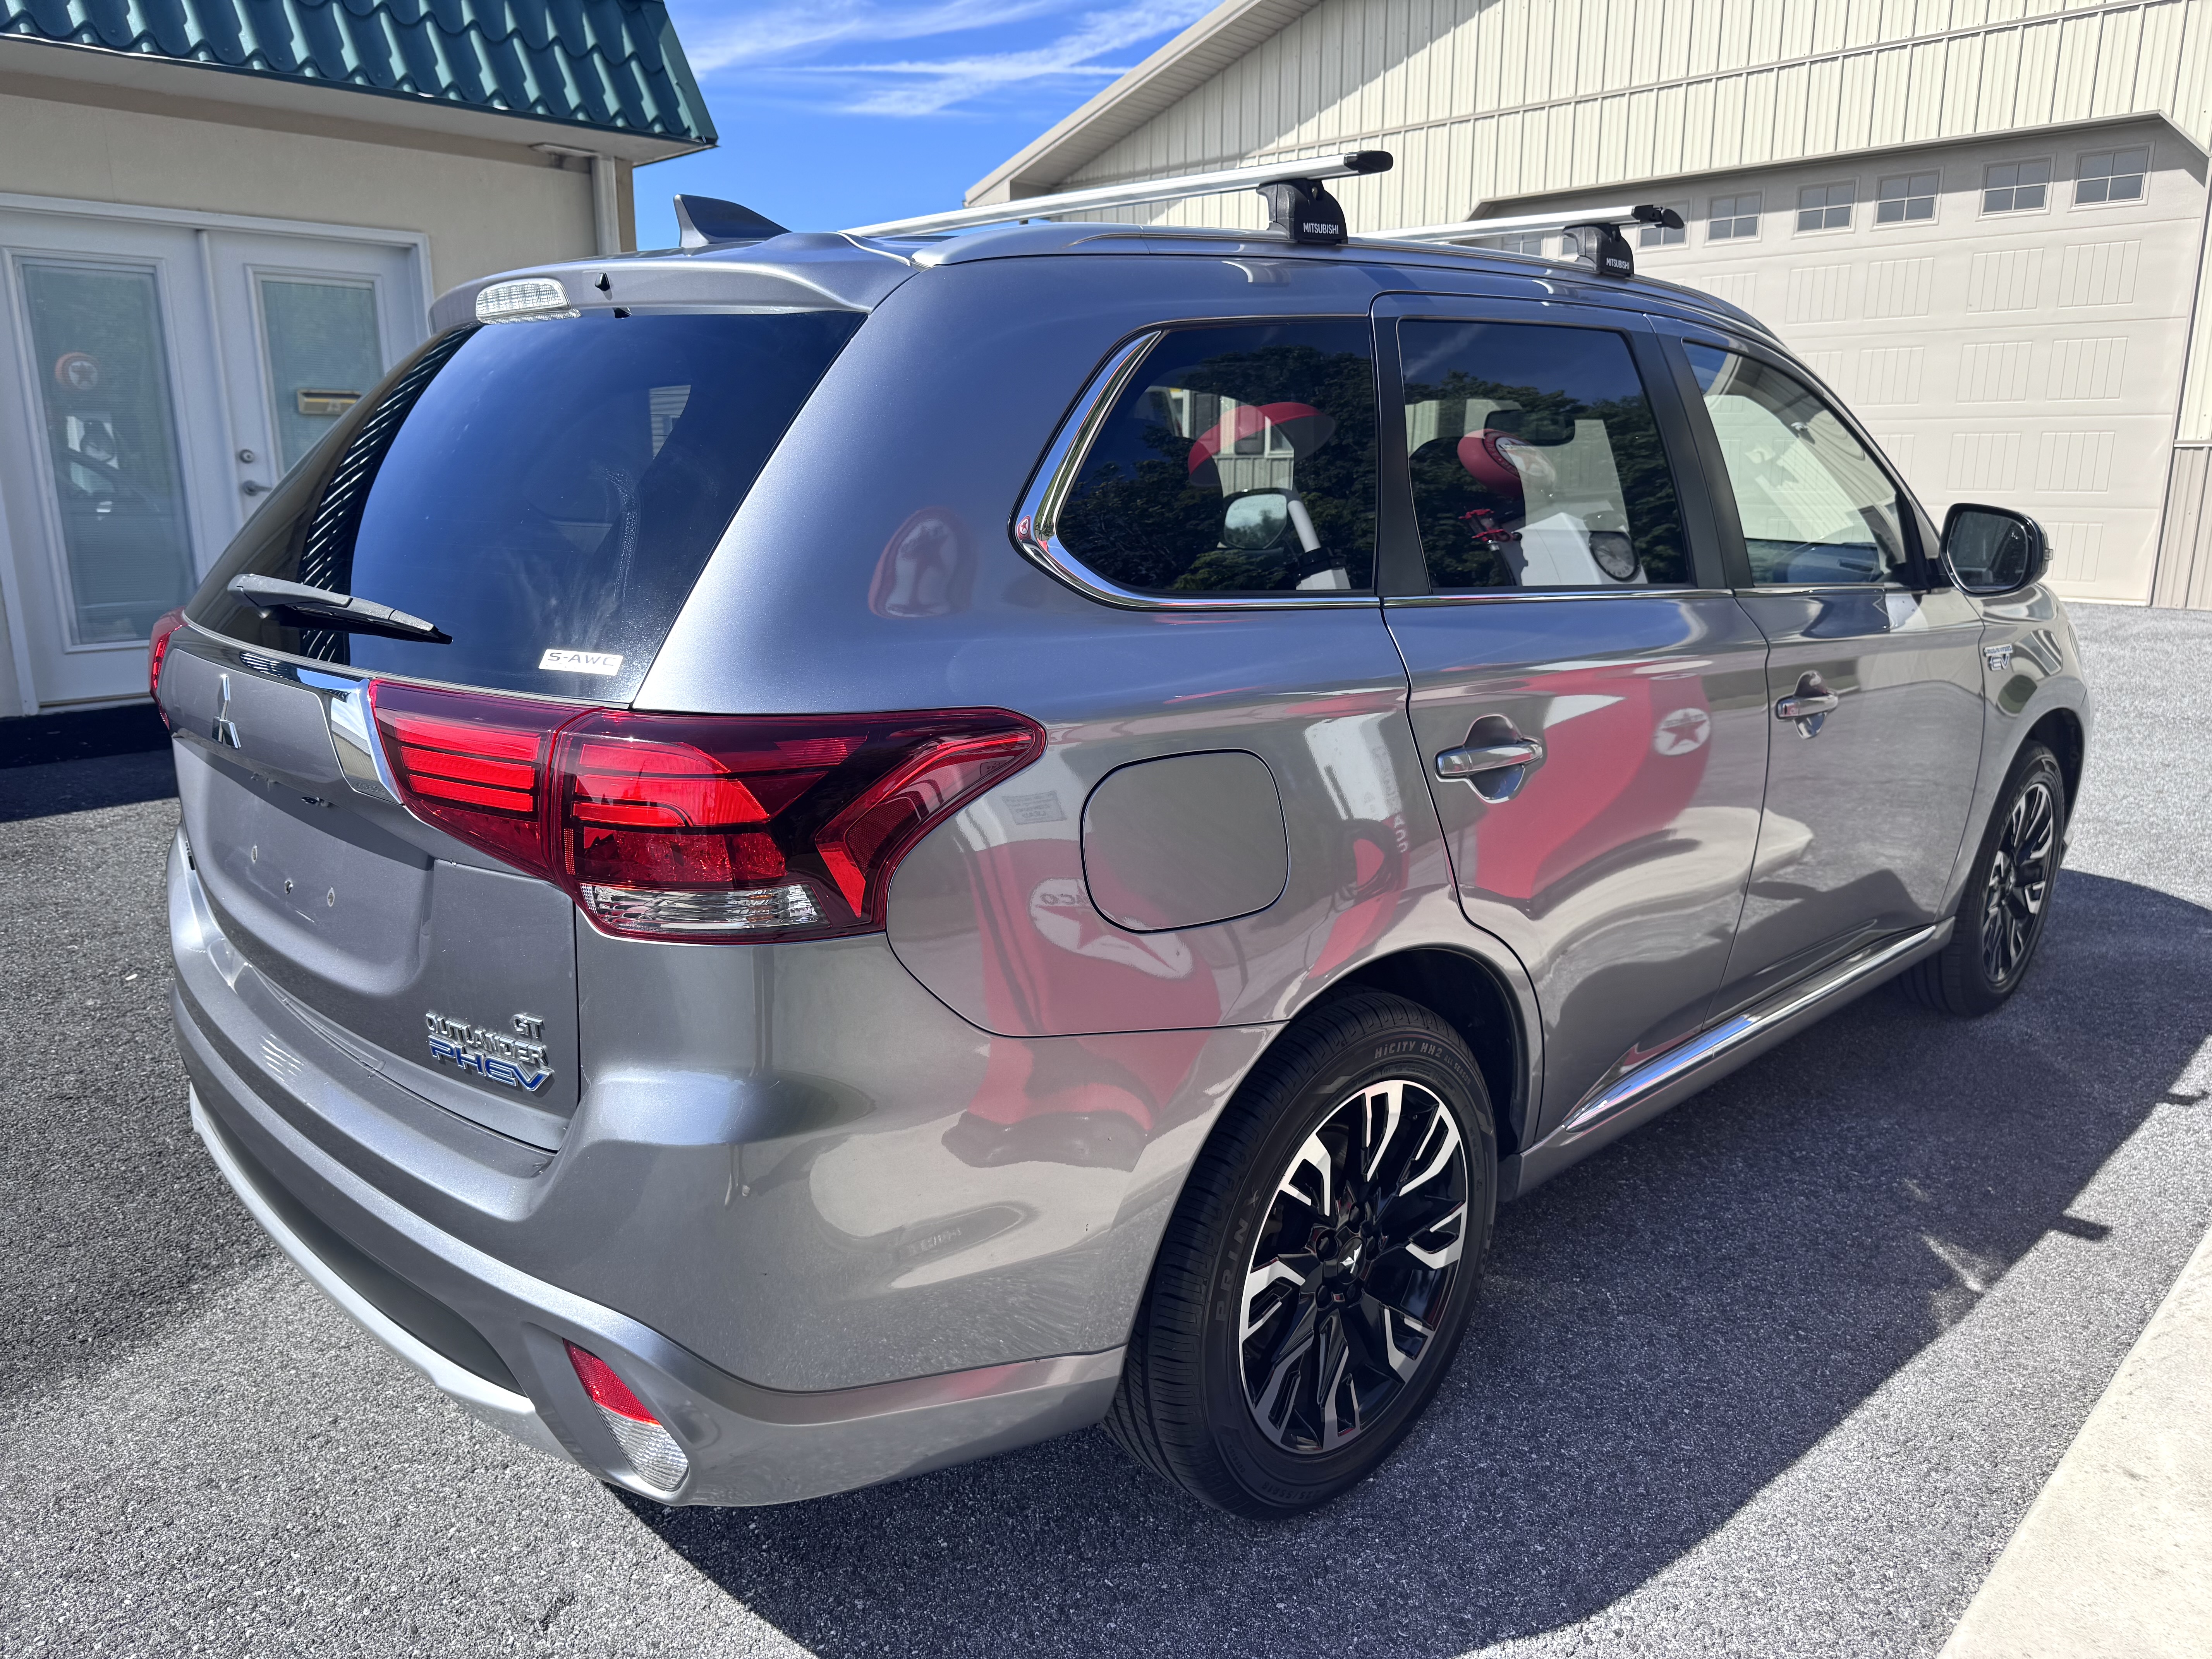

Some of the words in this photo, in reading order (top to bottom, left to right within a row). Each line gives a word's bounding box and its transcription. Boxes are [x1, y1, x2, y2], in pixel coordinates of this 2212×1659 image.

[1303, 222, 1339, 234] MITSUBISHI
[1606, 257, 1630, 270] MITSUBISHI
[548, 653, 617, 666] S-AWC
[1991, 653, 2009, 671] EV
[510, 1013, 543, 1038] GT
[426, 1011, 550, 1068] OUTLANDER
[1420, 1042, 1443, 1058] HH2
[428, 1034, 551, 1091] PHEV
